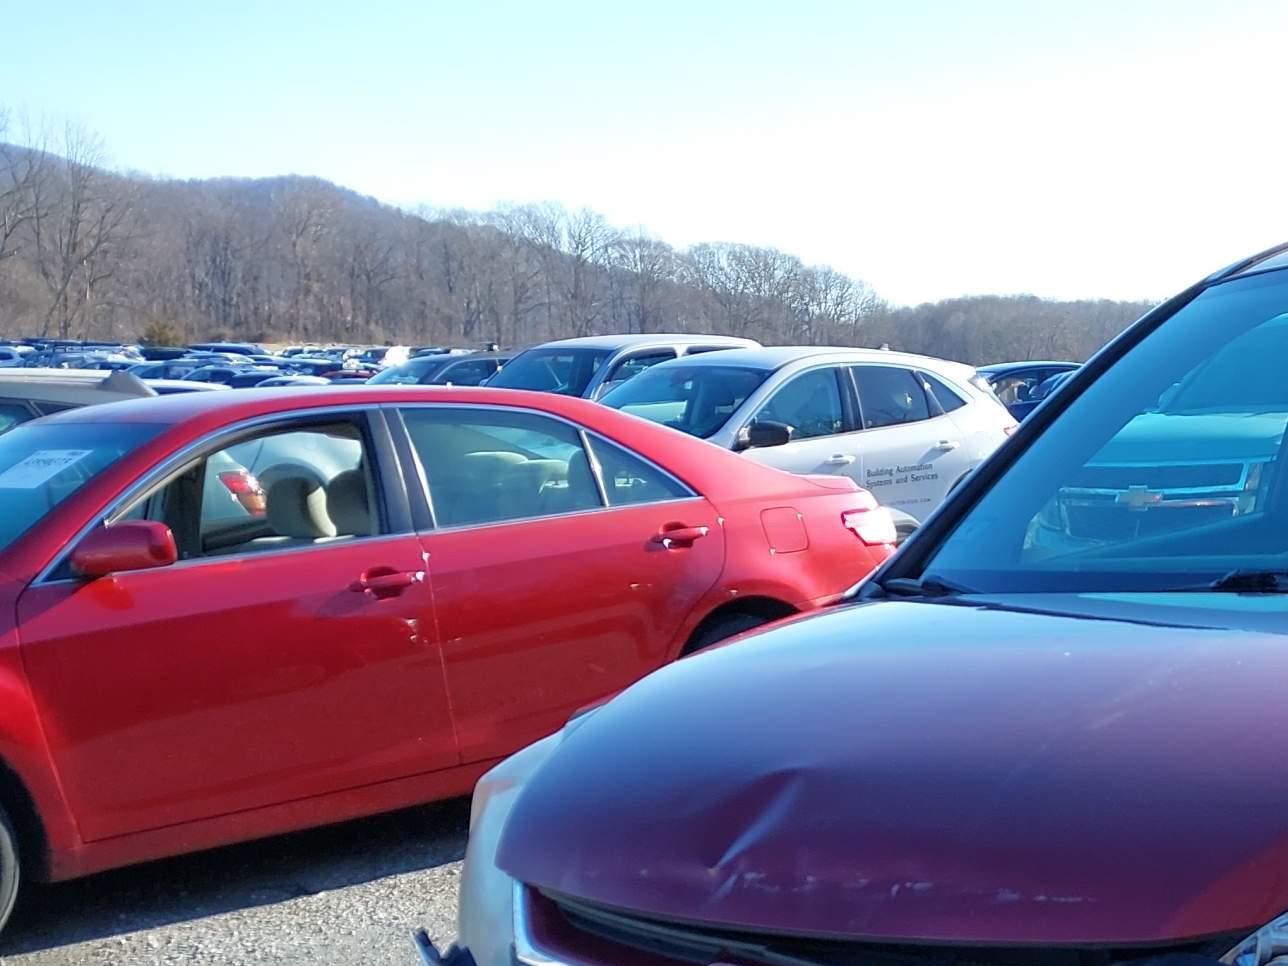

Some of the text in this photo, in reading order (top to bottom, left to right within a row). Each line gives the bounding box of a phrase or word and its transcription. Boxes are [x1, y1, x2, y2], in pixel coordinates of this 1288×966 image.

[866, 463, 933, 477] Building Automation
[865, 473, 939, 489] Systems and Services
